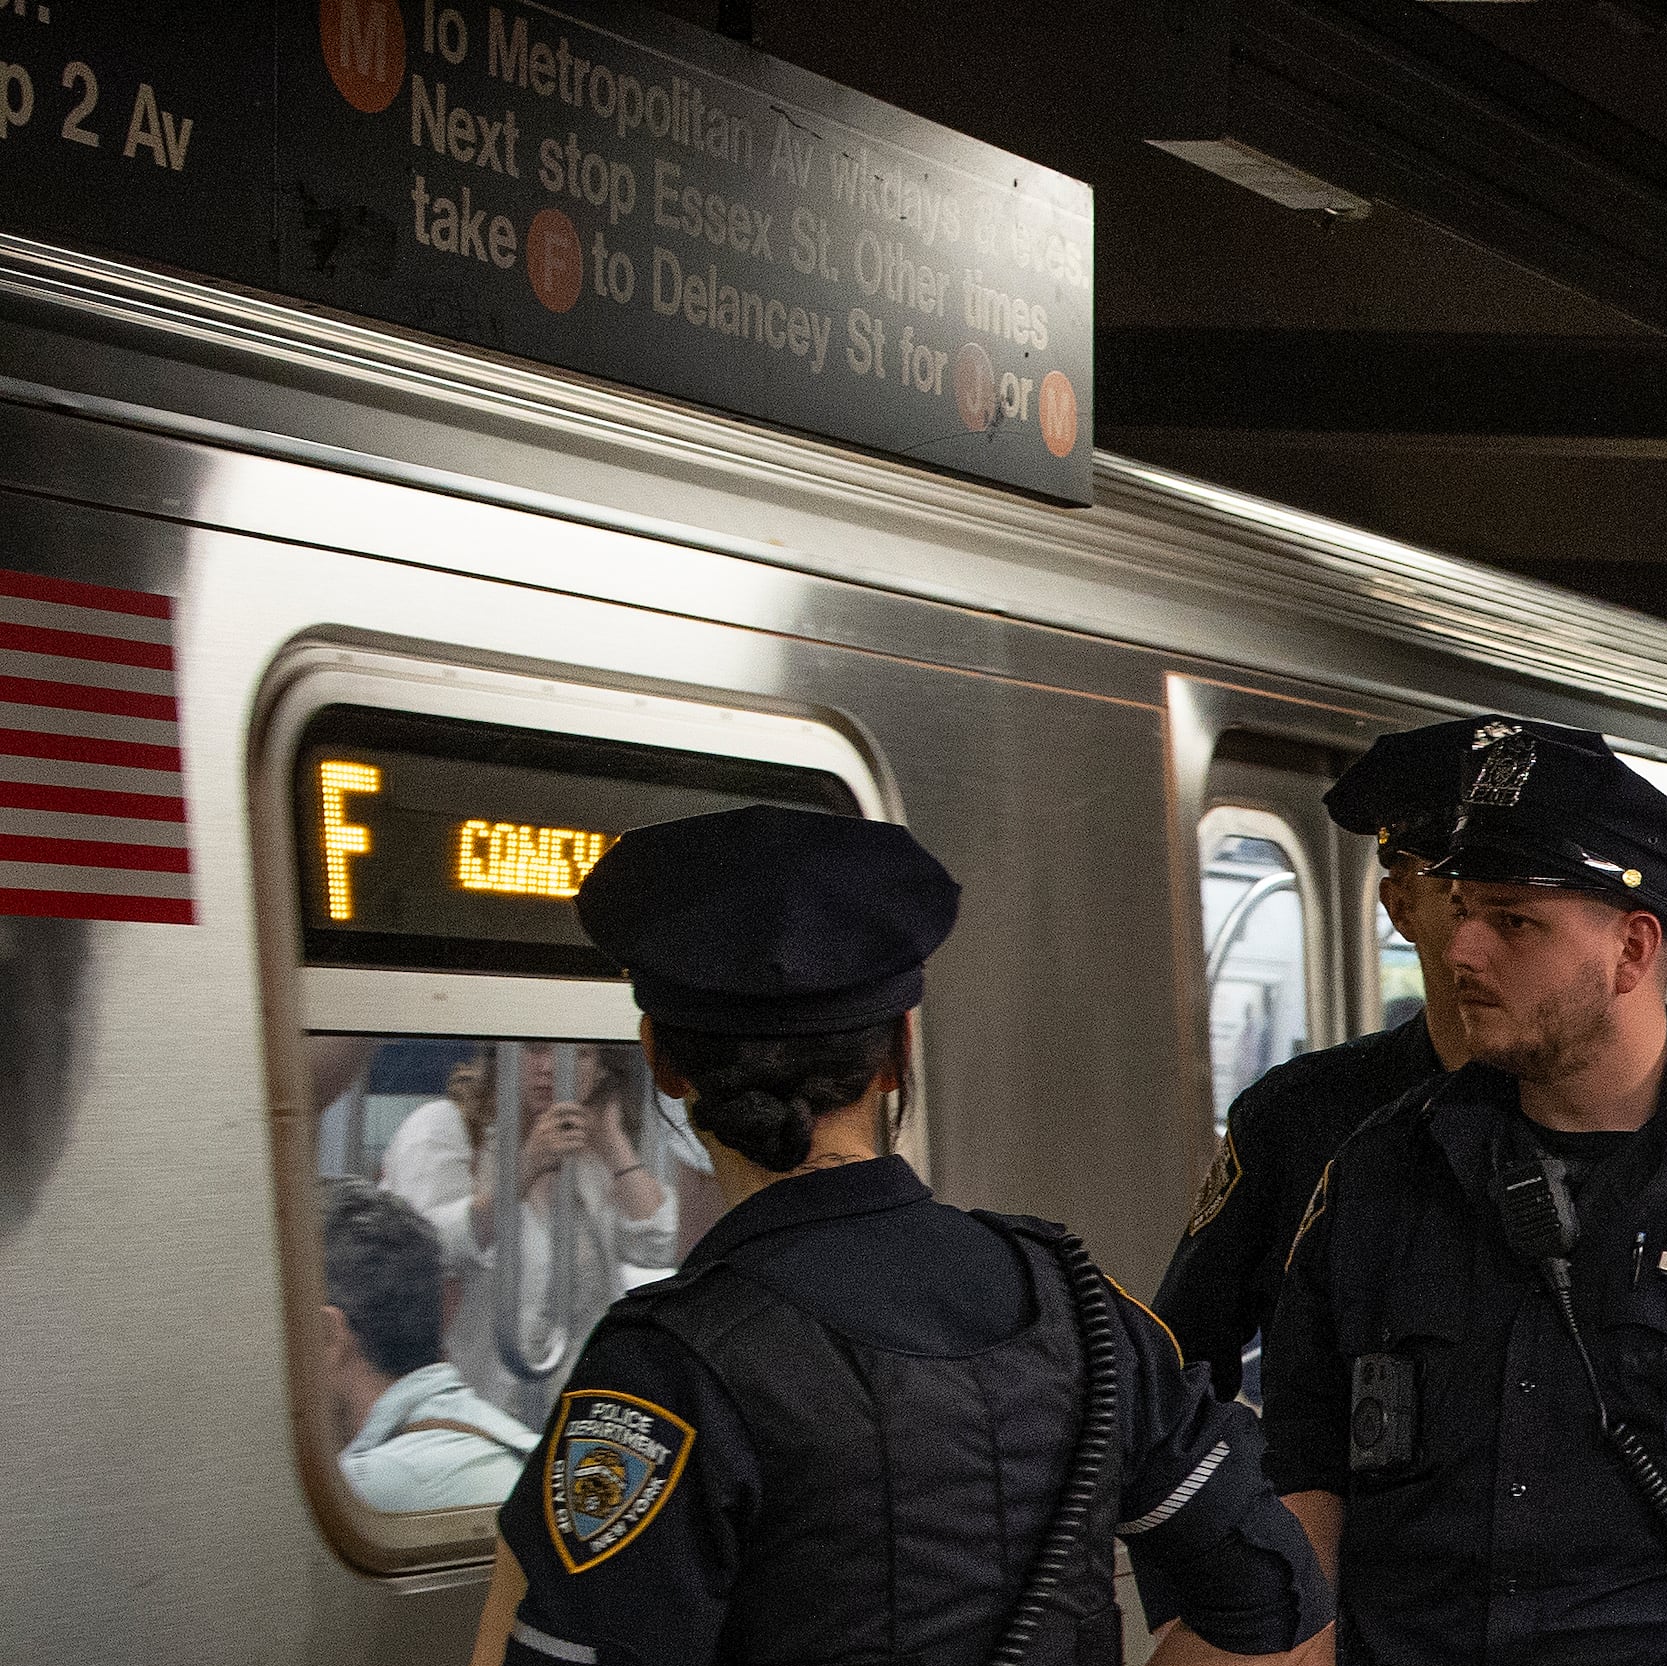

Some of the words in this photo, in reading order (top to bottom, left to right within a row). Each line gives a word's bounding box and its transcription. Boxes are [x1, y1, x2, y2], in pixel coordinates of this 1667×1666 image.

[61, 61, 100, 148] 2
[123, 83, 194, 171] Av
[411, 74, 520, 179] Next
[539, 133, 636, 225] stop
[655, 159, 774, 263] Essex
[792, 205, 840, 283] St.
[854, 230, 951, 317] Other
[963, 268, 1050, 351] times
[489, 8, 753, 163] Metropolitan
[771, 114, 812, 187] Av
[831, 147, 960, 246] wkdays
[411, 175, 517, 269] take
[543, 233, 571, 291] F
[592, 231, 635, 304] to
[652, 246, 831, 376] Delancey
[846, 307, 886, 379] St
[901, 327, 948, 396] for
[1000, 371, 1033, 422] or
[1046, 390, 1073, 441] M
[320, 761, 380, 920] F
[588, 1402, 655, 1434] POLICE
